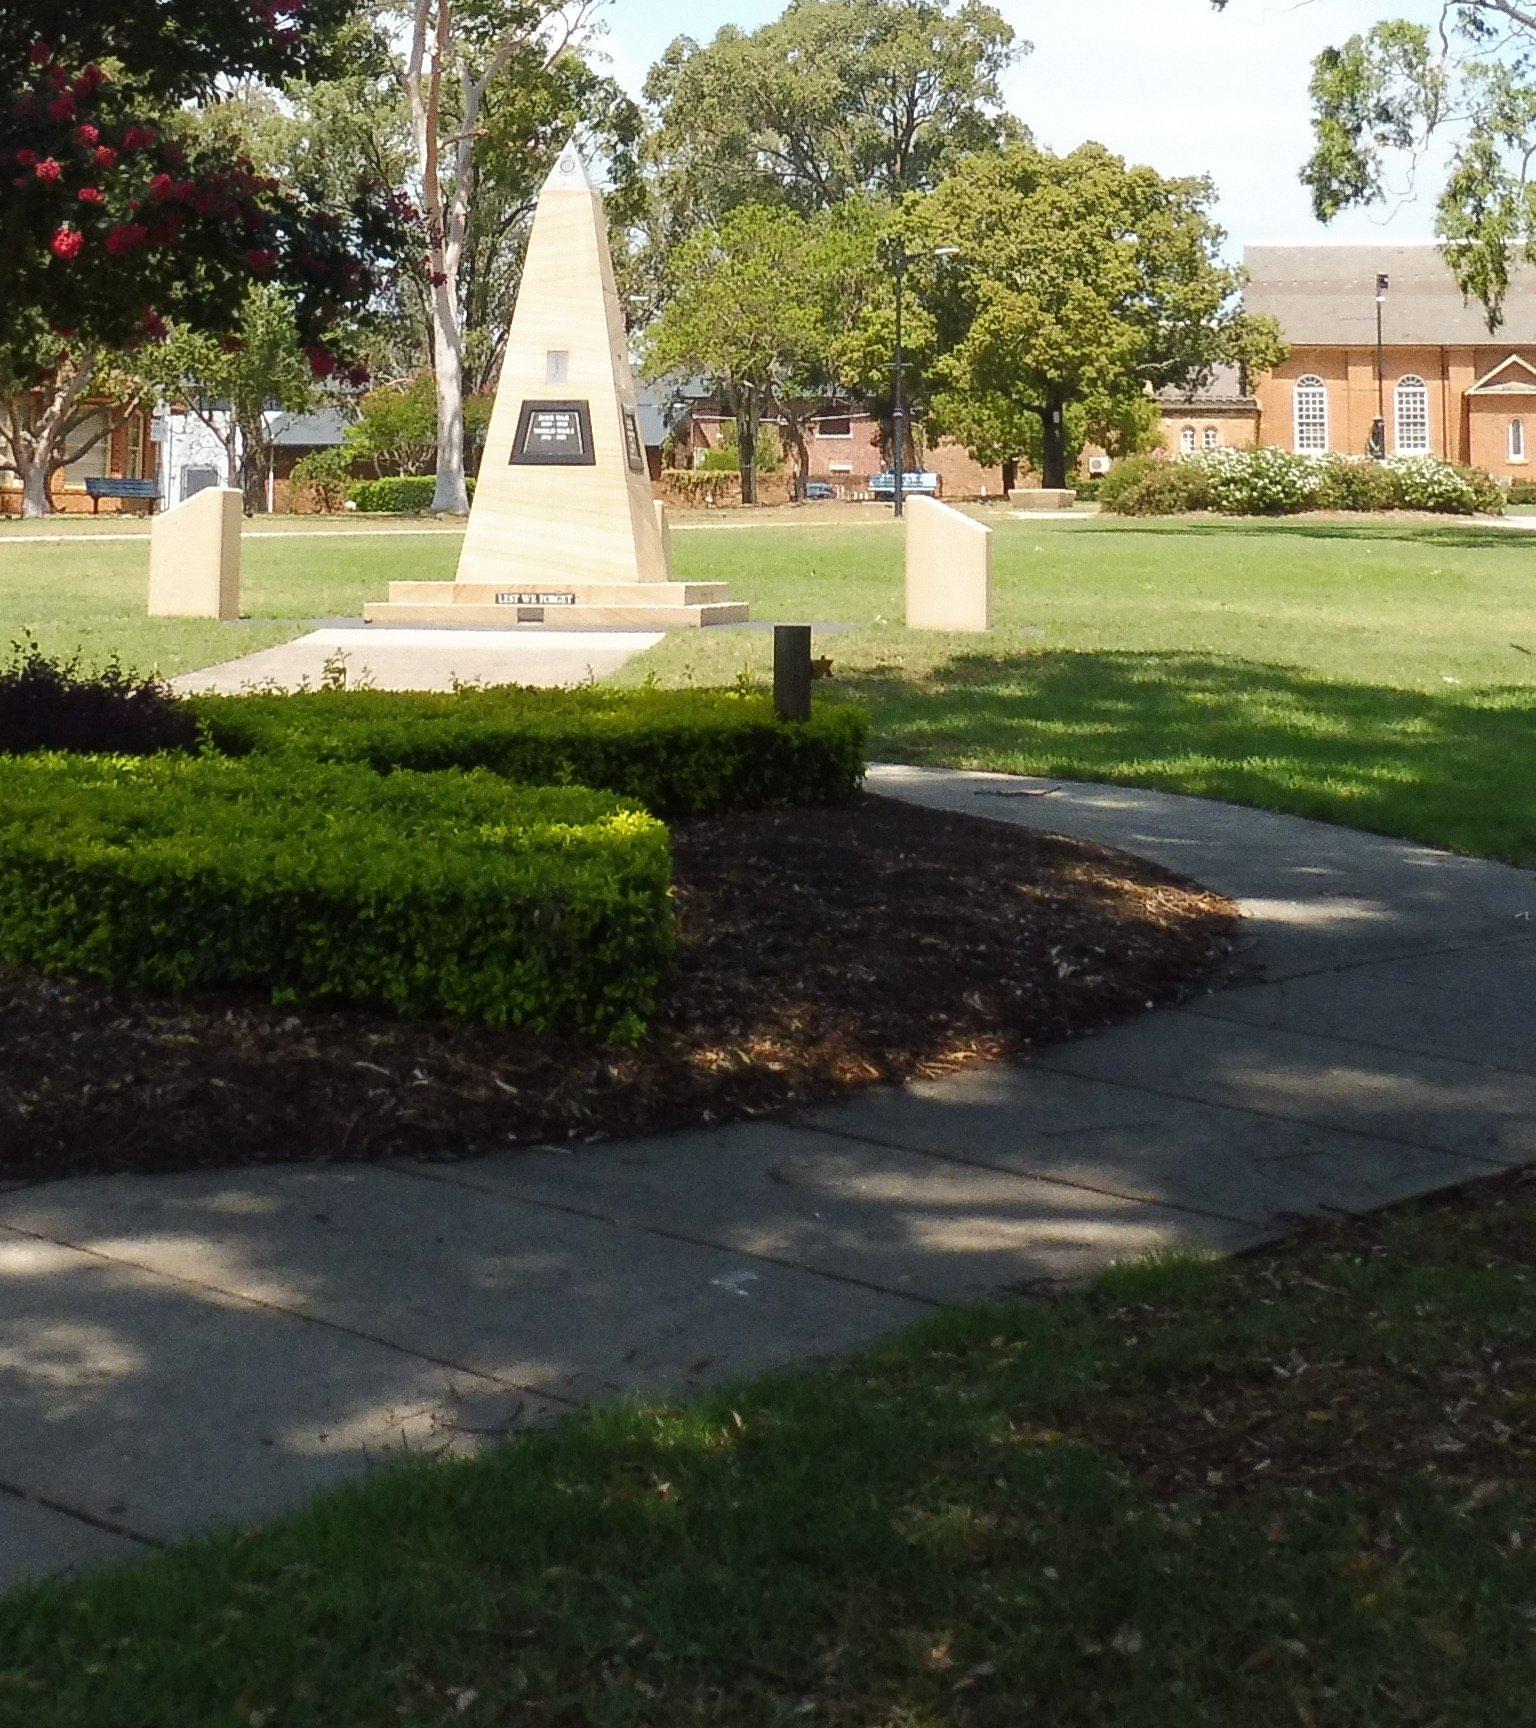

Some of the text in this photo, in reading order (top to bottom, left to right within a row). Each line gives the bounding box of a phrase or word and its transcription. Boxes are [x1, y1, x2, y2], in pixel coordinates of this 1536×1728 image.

[498, 594, 573, 604] LEST WE FORGET
